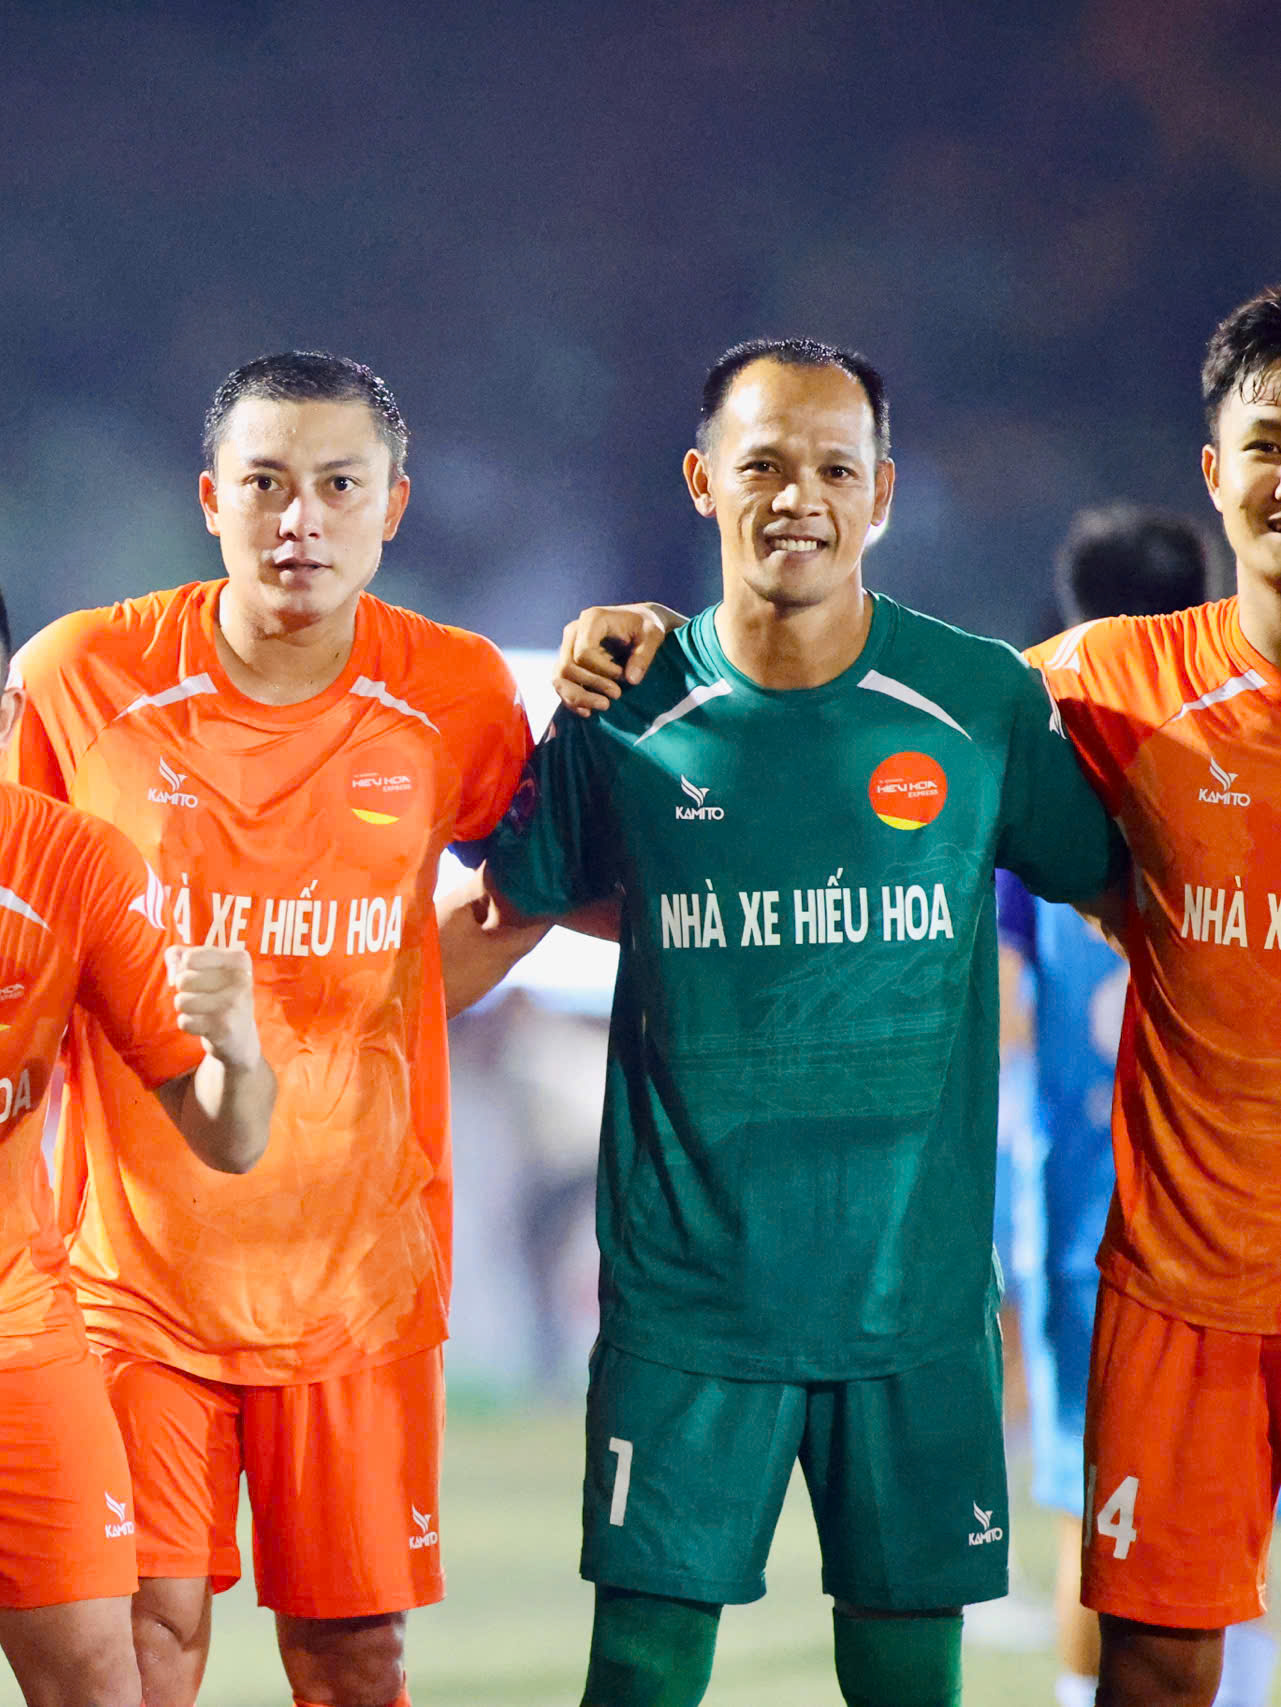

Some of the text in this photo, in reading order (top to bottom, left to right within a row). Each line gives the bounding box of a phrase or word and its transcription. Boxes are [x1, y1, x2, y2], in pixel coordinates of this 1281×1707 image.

[147, 788, 198, 808] KAMITO
[1198, 788, 1251, 807] KAMITO
[675, 806, 724, 821] KAMITO
[660, 867, 954, 949] NHÀ XE HIẾU HOA
[1181, 875, 1248, 948] NHÀ
[203, 892, 252, 950] XE
[260, 880, 337, 957] HIẾU
[346, 895, 402, 955] HOA
[609, 1436, 633, 1527] 1
[409, 1531, 438, 1550] KAMITO
[968, 1526, 1003, 1546] KAMITO
